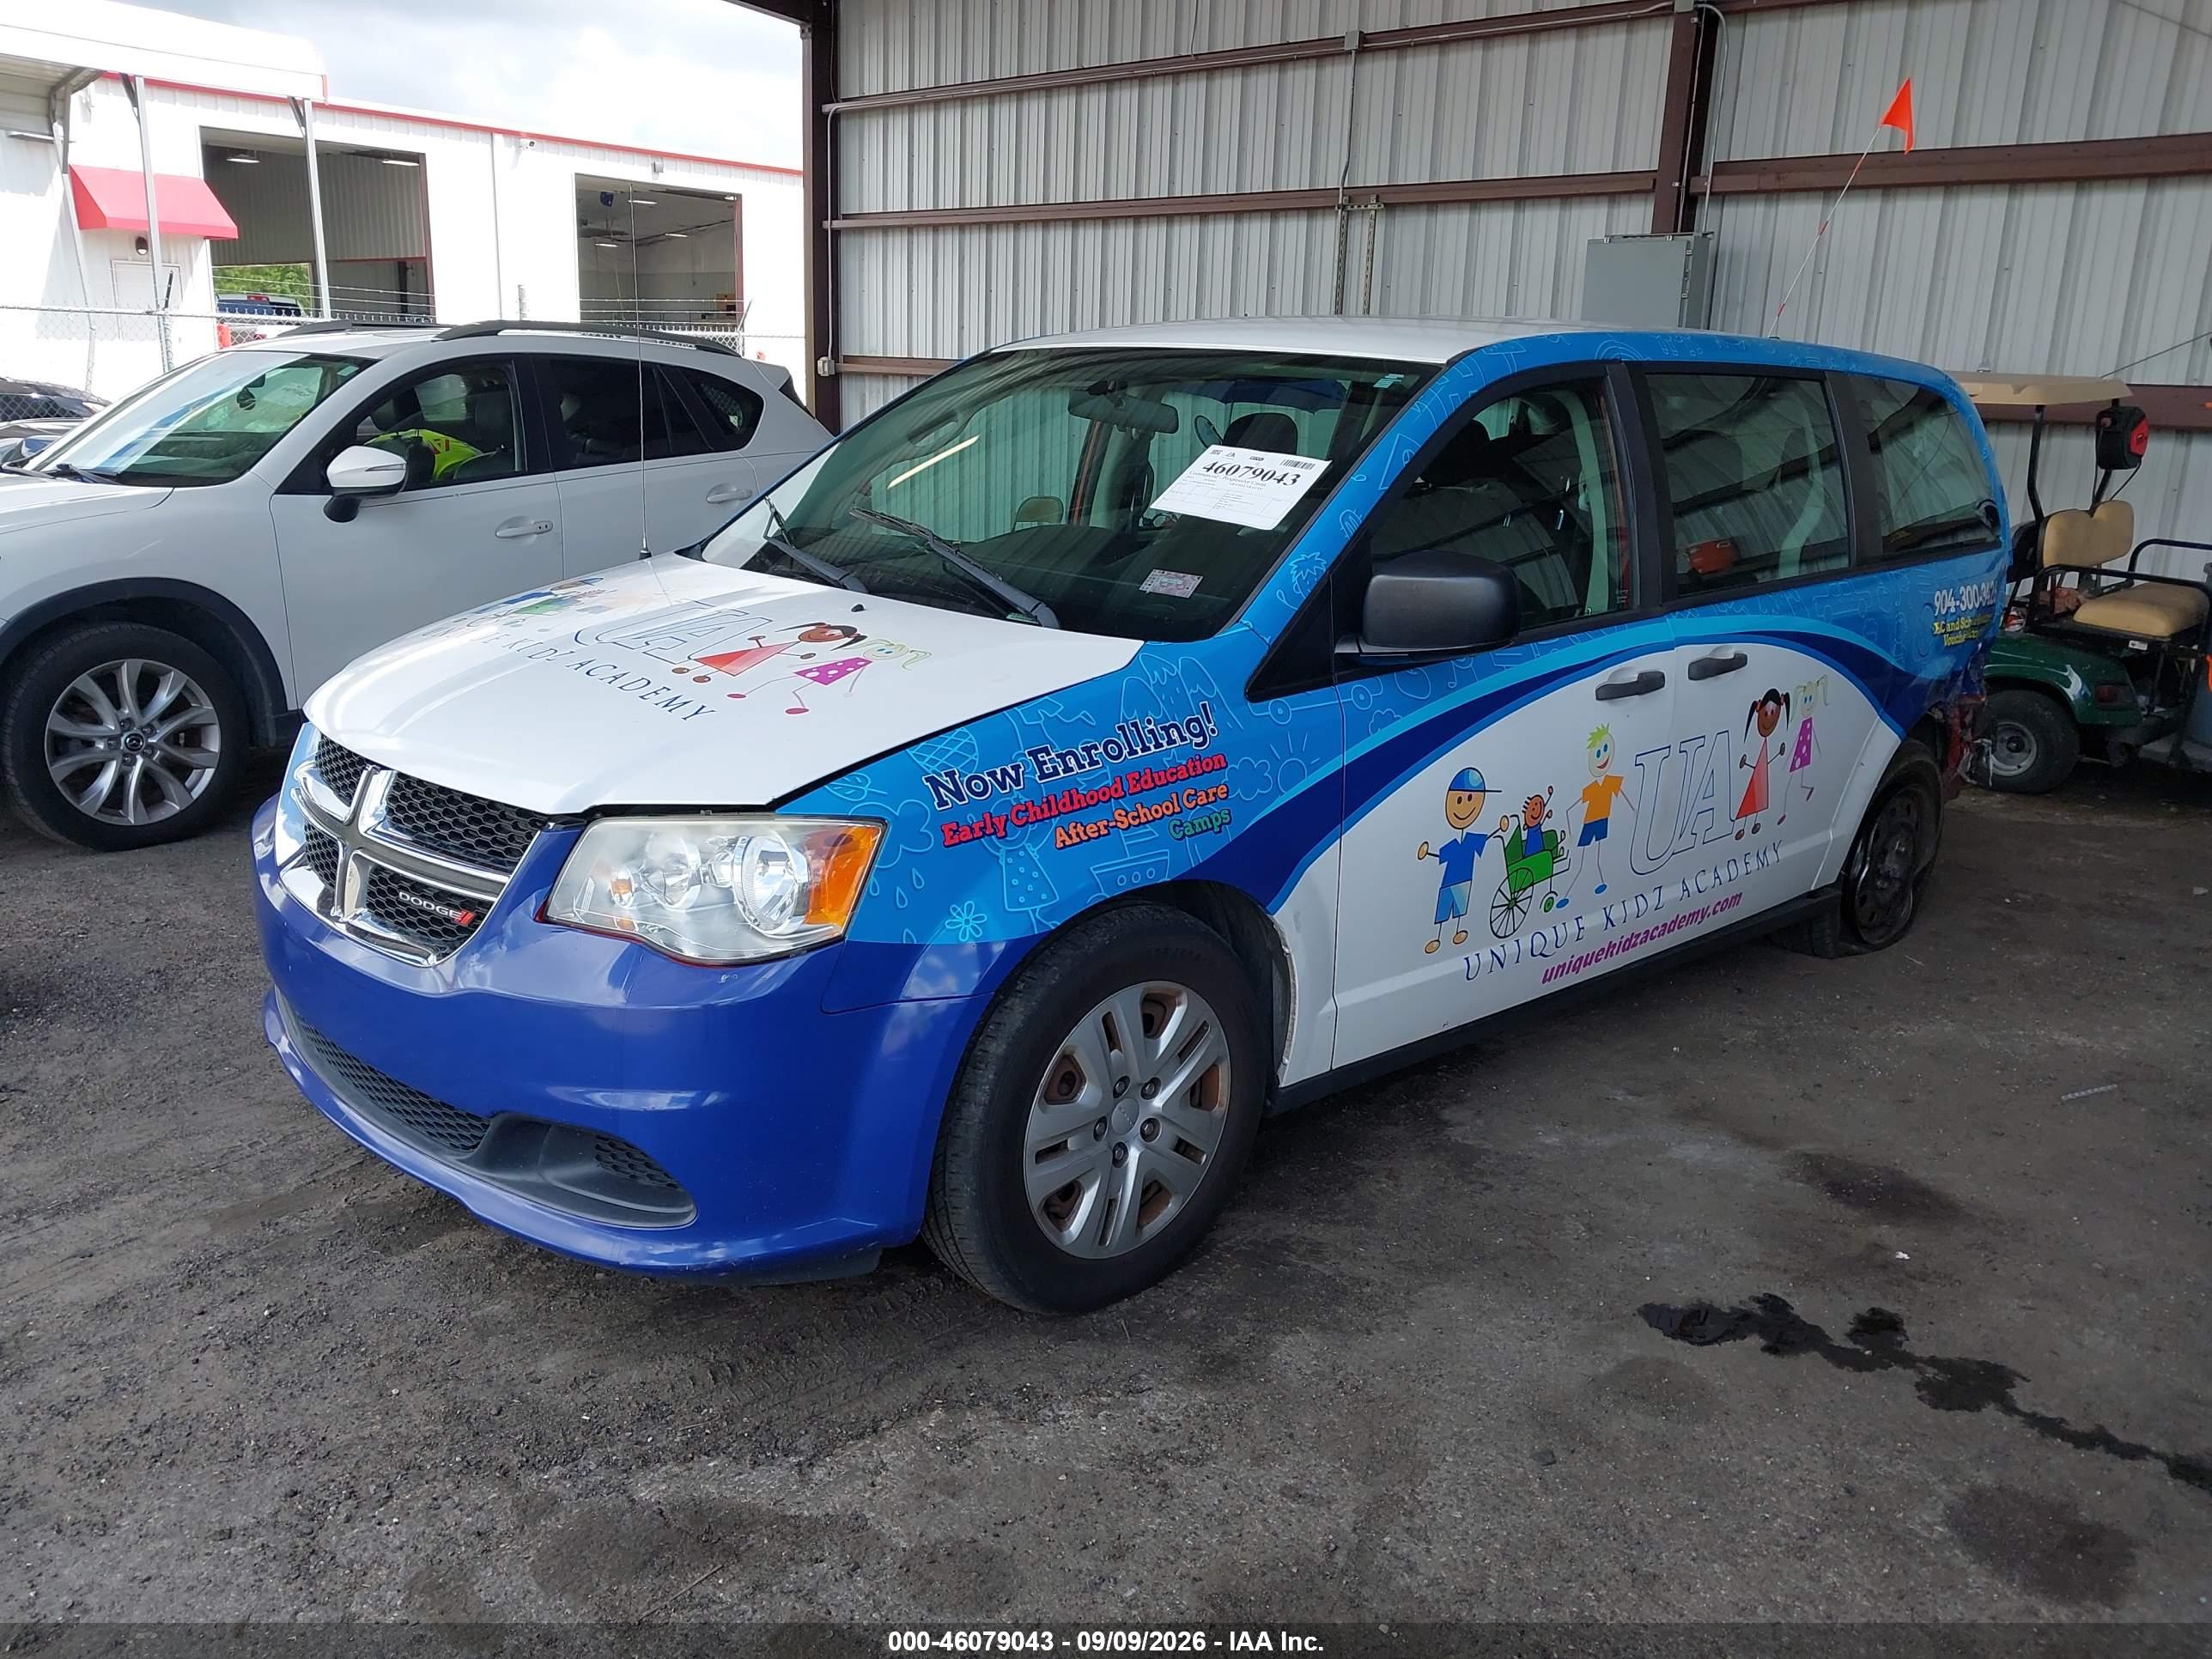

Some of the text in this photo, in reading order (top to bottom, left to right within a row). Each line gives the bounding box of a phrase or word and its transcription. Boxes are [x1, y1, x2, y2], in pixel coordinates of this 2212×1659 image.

[1202, 461, 1301, 486] 46079043
[1946, 617, 1959, 631] and
[564, 659, 717, 720] ACADEMY
[922, 701, 1219, 811] Now Enrolling!
[942, 752, 1228, 847] Early Childhood Education
[1054, 783, 1230, 849] After-School Care
[1168, 808, 1231, 841] Camps
[1630, 729, 1735, 876] UA
[398, 891, 463, 920] DODGE
[1464, 839, 1784, 982] UNIQUE KIDZ ACADEMY
[1541, 890, 1743, 985] uniquekidzacademy.com
